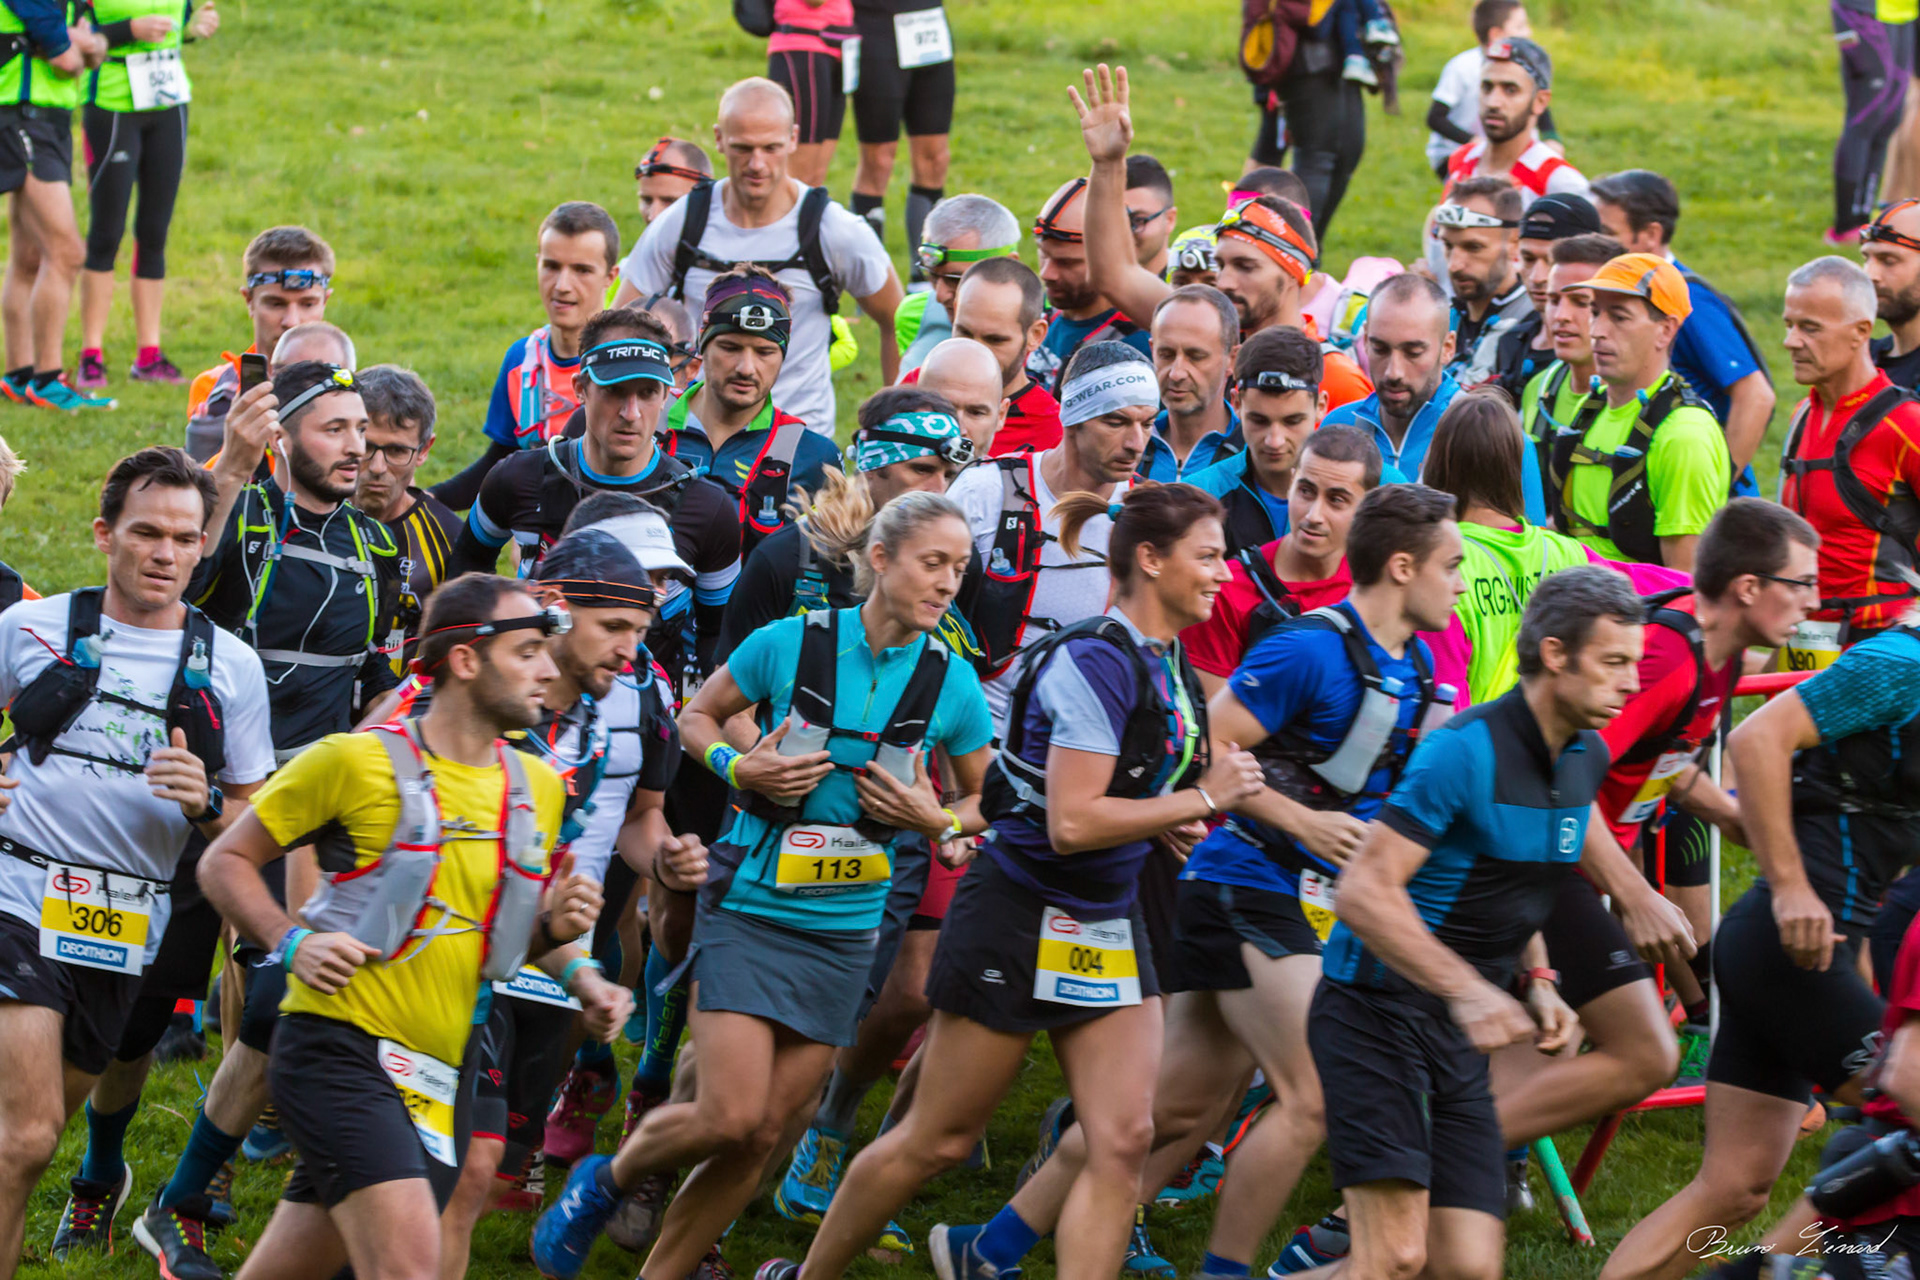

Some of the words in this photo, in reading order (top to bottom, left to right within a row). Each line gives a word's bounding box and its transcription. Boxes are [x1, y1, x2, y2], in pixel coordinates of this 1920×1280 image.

[607, 346, 661, 361] TRITYC
[812, 859, 862, 880] 113
[72, 906, 124, 937] 306
[59, 940, 125, 964] DECATHLON
[1068, 946, 1105, 975] 004
